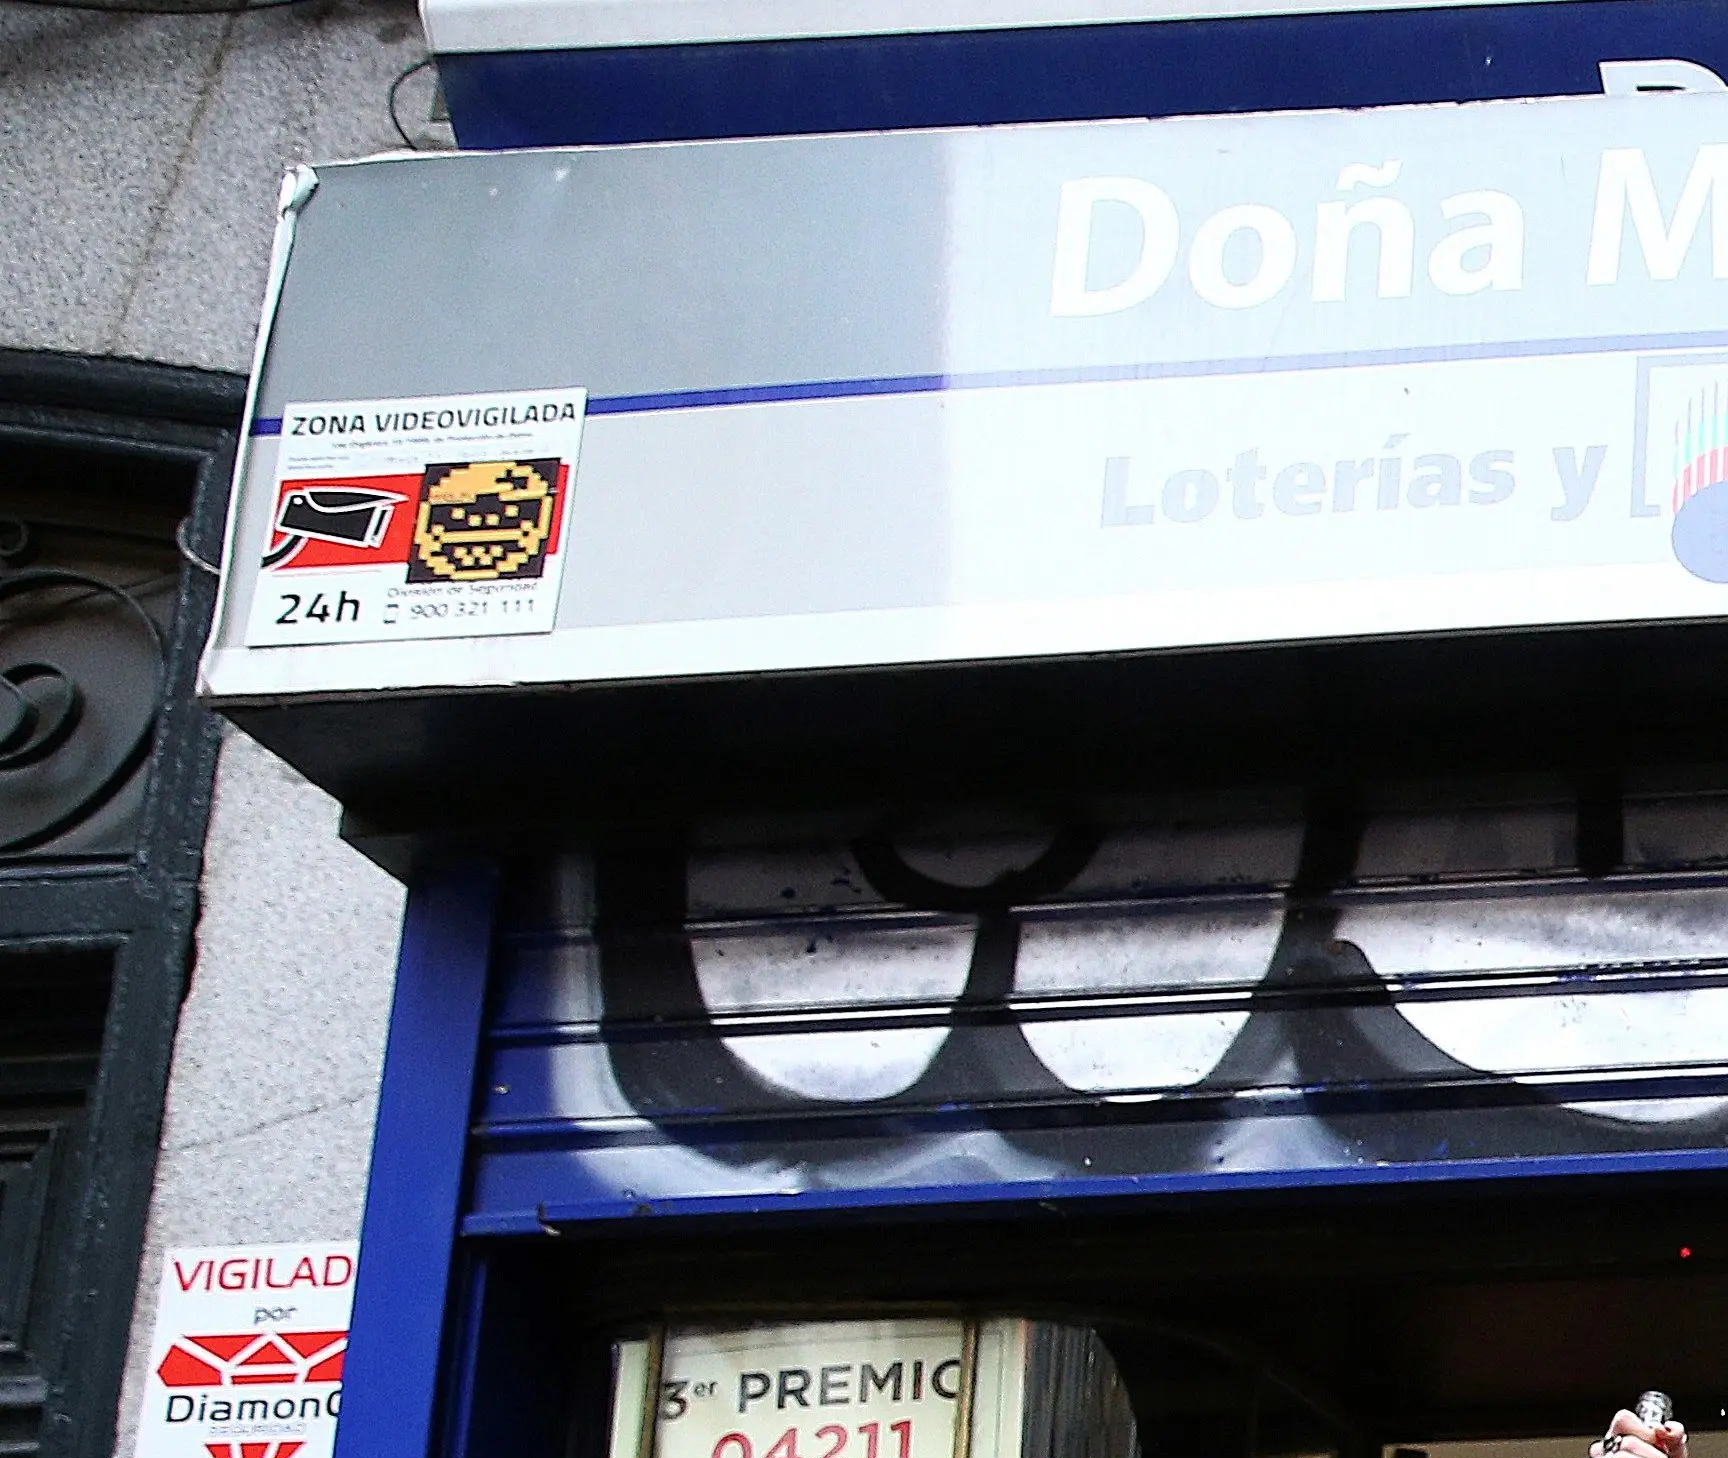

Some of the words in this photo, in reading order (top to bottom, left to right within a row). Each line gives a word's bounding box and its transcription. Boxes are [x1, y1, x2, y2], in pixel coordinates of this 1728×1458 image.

[1049, 158, 1527, 318] Doña
[291, 414, 366, 437] ZONA
[374, 401, 577, 433] VIDEOVIGILADA
[1100, 428, 1516, 528] Loterías
[1548, 438, 1609, 524] y
[275, 590, 362, 626] 24h
